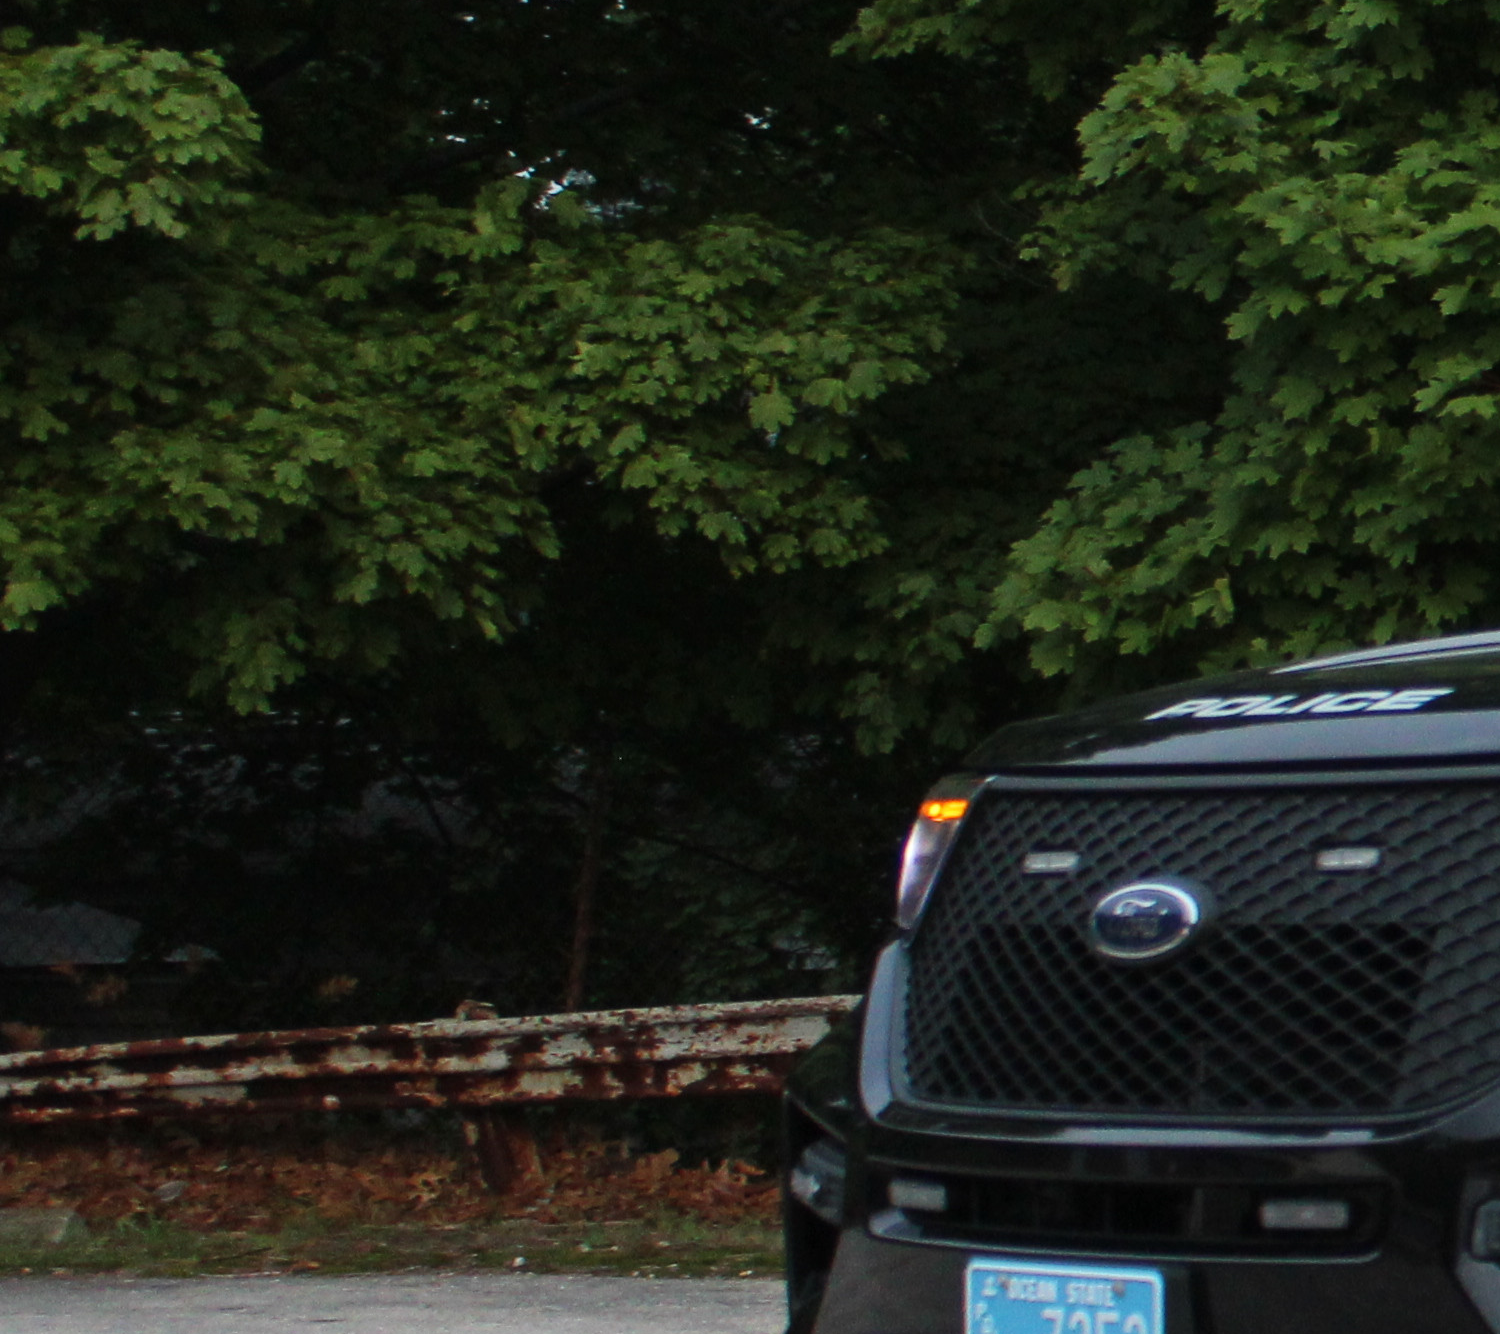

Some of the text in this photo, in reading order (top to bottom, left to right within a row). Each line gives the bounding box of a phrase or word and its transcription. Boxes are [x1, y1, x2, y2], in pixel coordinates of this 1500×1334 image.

[1144, 687, 1456, 721] POLICE
[1007, 1277, 1115, 1308] OCEAN STATE
